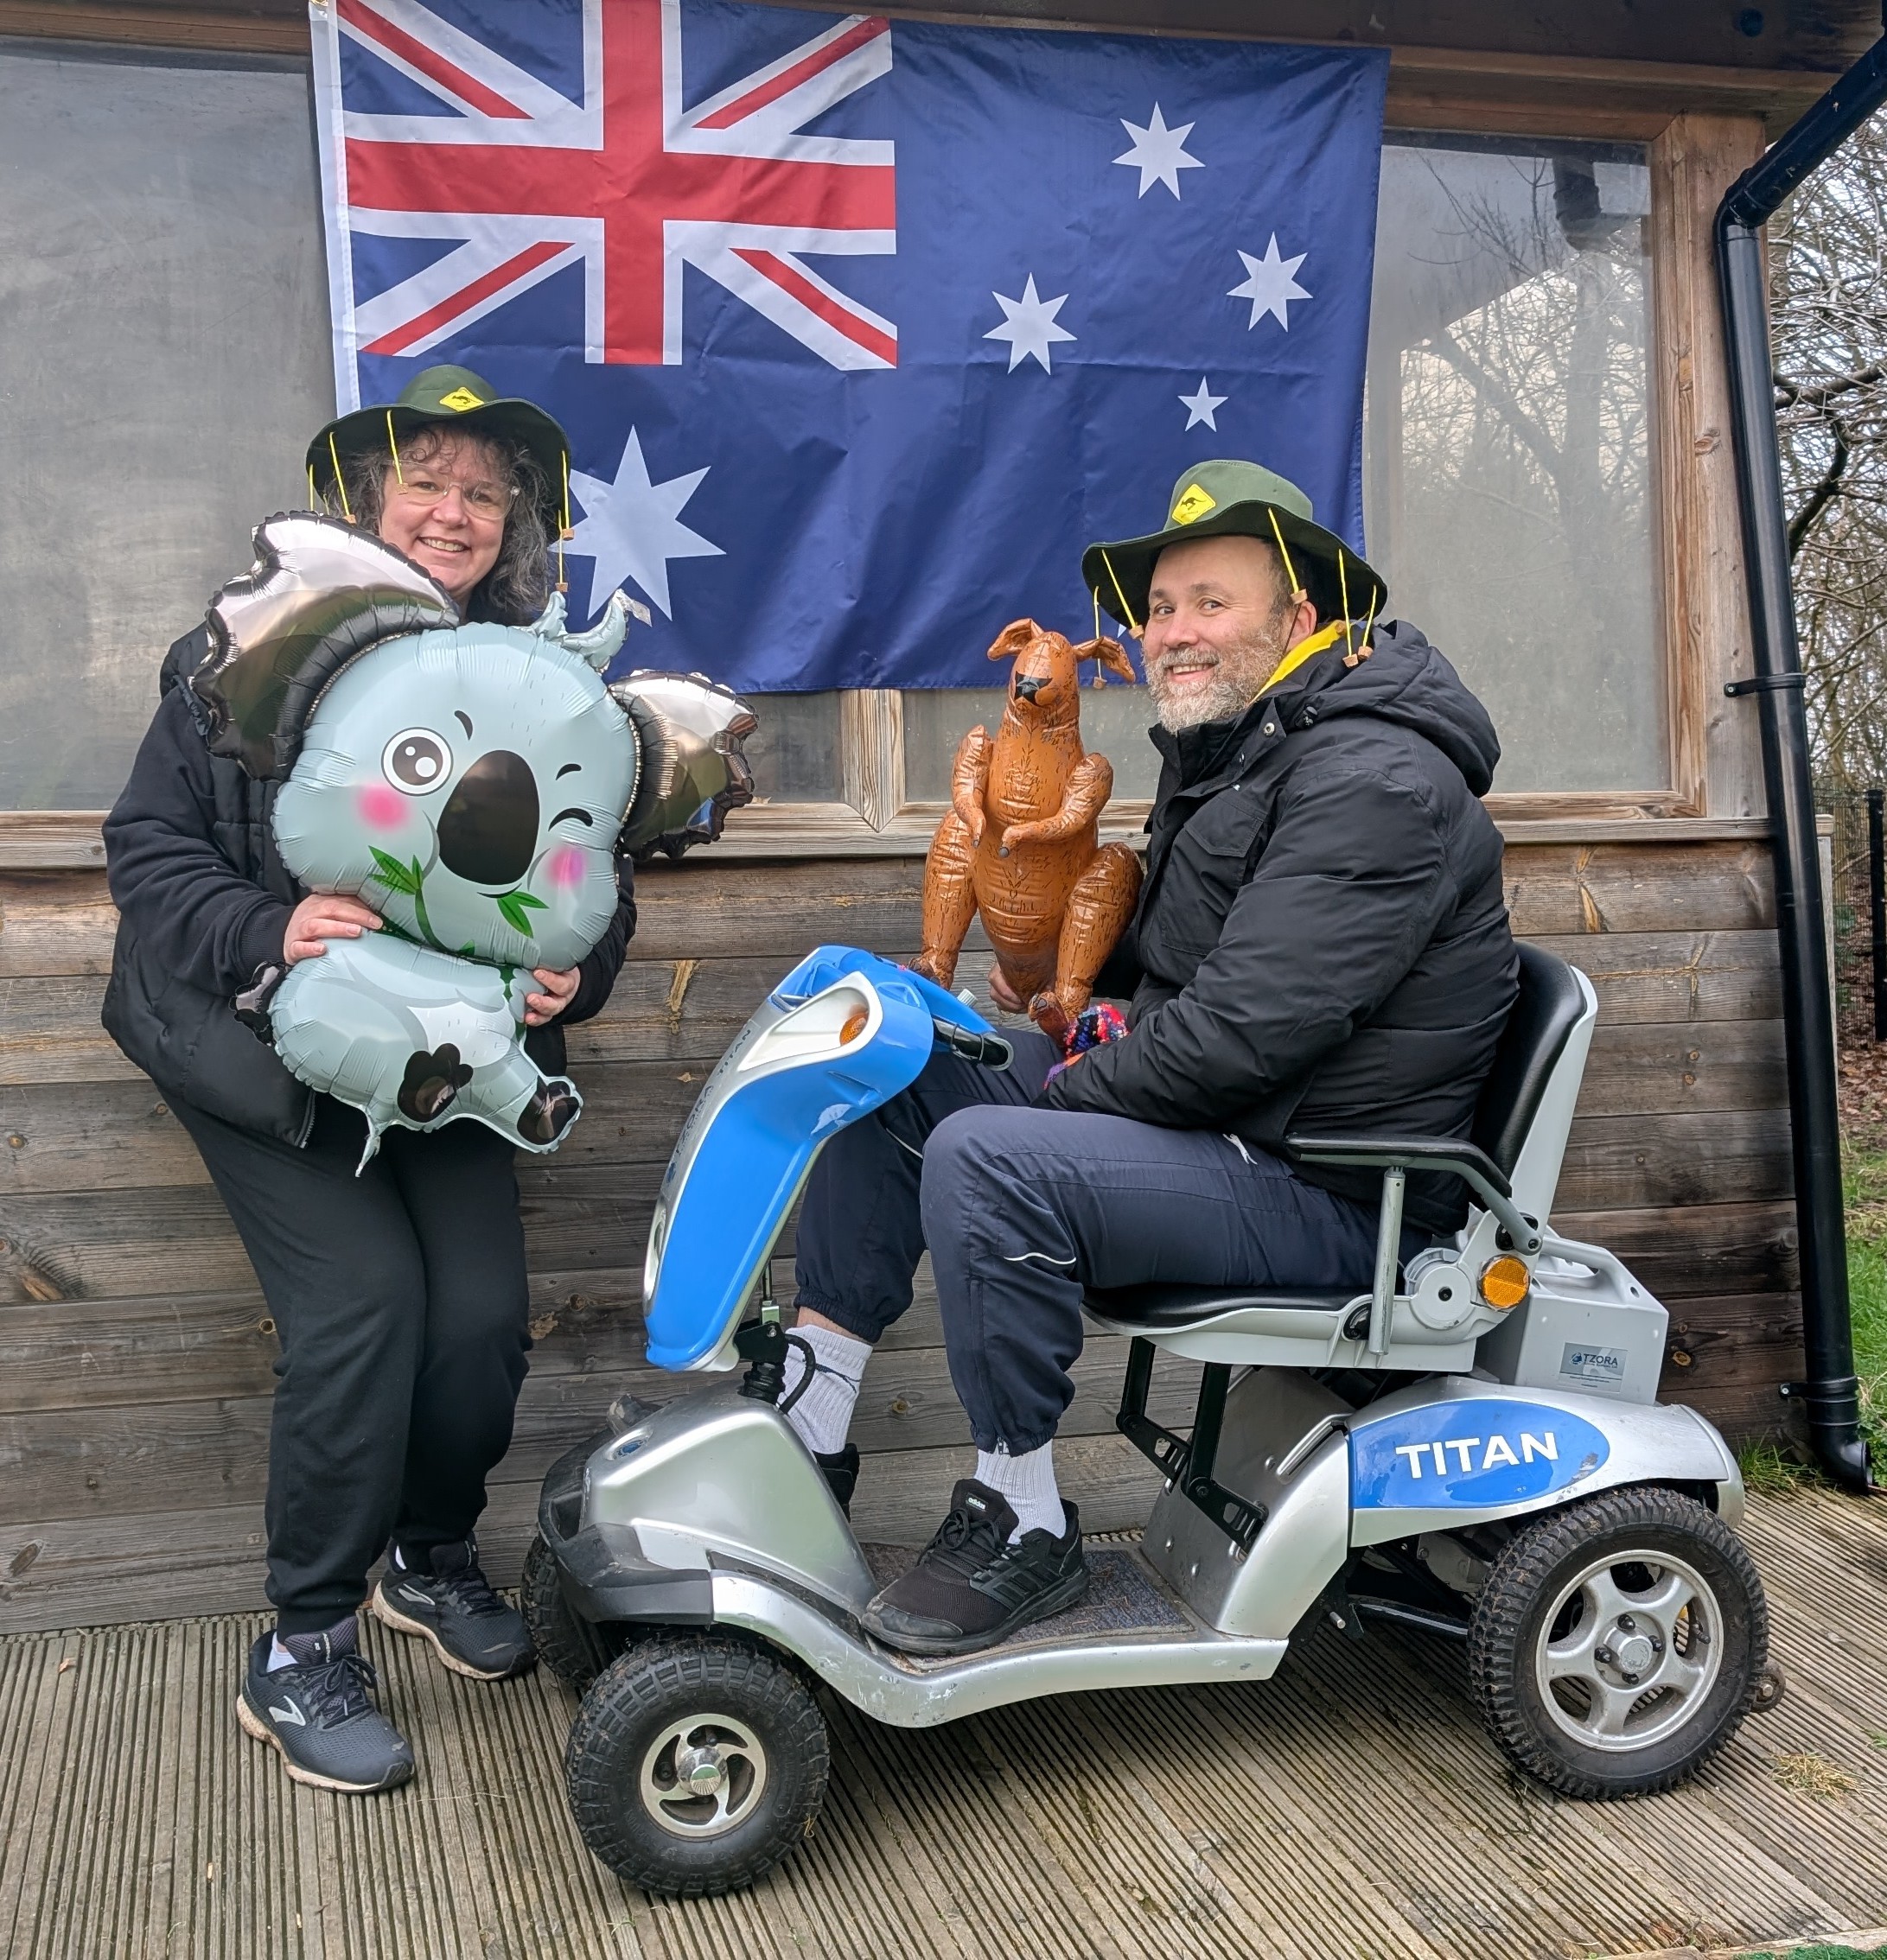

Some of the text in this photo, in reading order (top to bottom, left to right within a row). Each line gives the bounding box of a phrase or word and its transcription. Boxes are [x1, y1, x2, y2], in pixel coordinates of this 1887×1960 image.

[717, 1028, 751, 1077] TITAN
[1583, 1352, 1619, 1365] TZORA
[1395, 1431, 1559, 1480] TITAN
